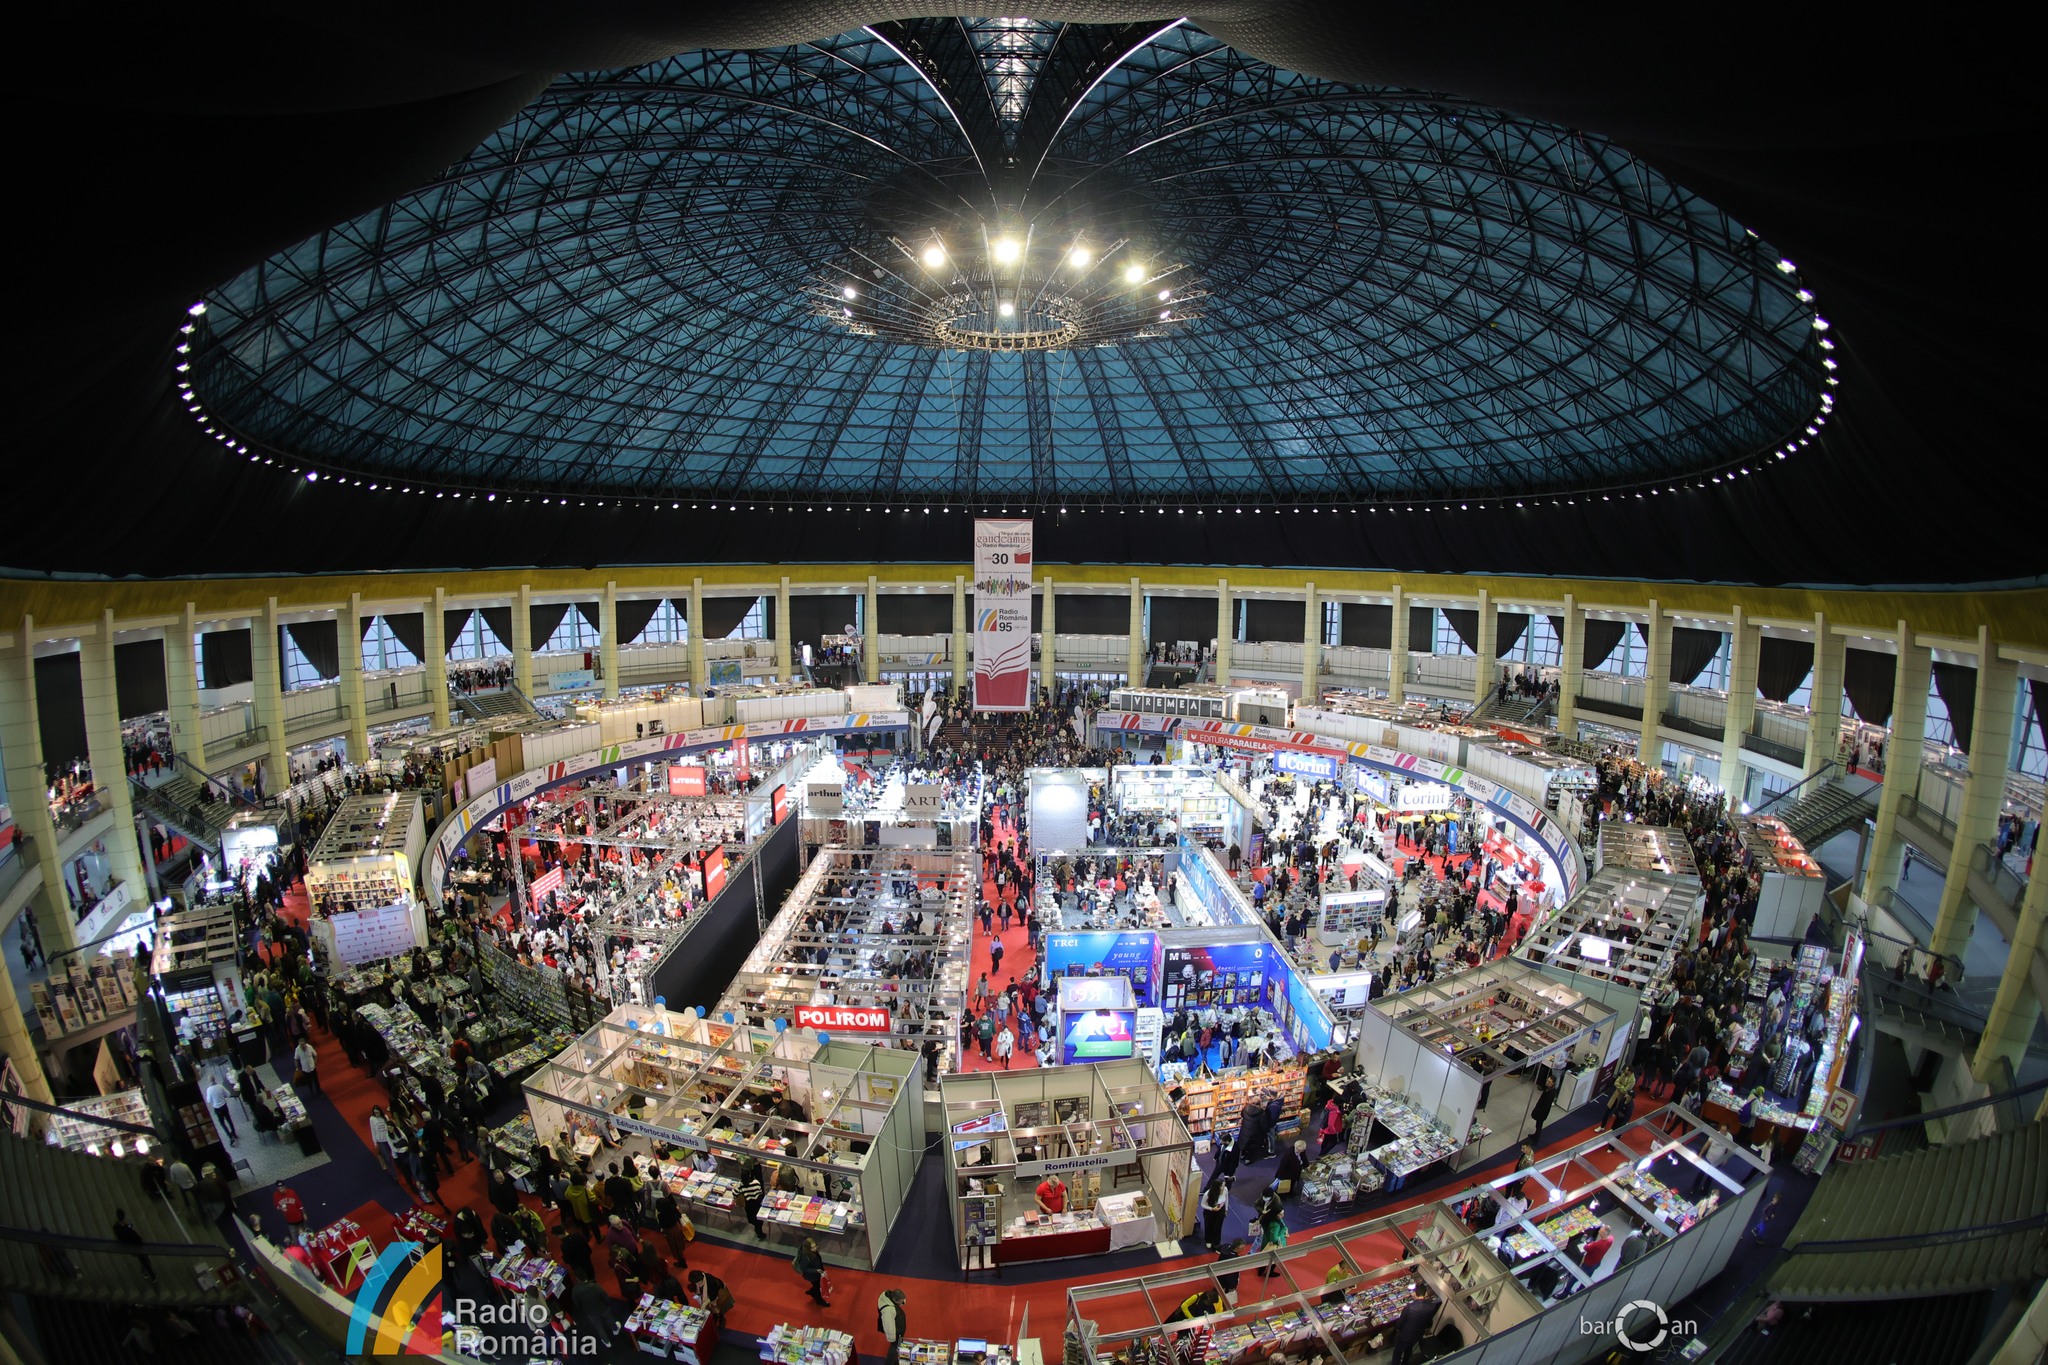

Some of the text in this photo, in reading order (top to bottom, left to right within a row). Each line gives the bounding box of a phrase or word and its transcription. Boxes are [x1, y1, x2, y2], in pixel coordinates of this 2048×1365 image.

[992, 553, 1009, 565] 30
[998, 622, 1012, 632] 95
[1134, 696, 1198, 710] VREMEA
[1254, 732, 1278, 741] România
[1286, 756, 1332, 776] Corint
[672, 777, 702, 785] LITERA
[808, 789, 842, 798] arthur
[1403, 791, 1445, 805] Corint
[906, 796, 940, 806] ART
[1112, 952, 1142, 960] young
[799, 1010, 885, 1027] POLIROM
[616, 1118, 638, 1130] Editura
[640, 1126, 670, 1140] Portocala
[1045, 1157, 1108, 1171] Romfilatelia
